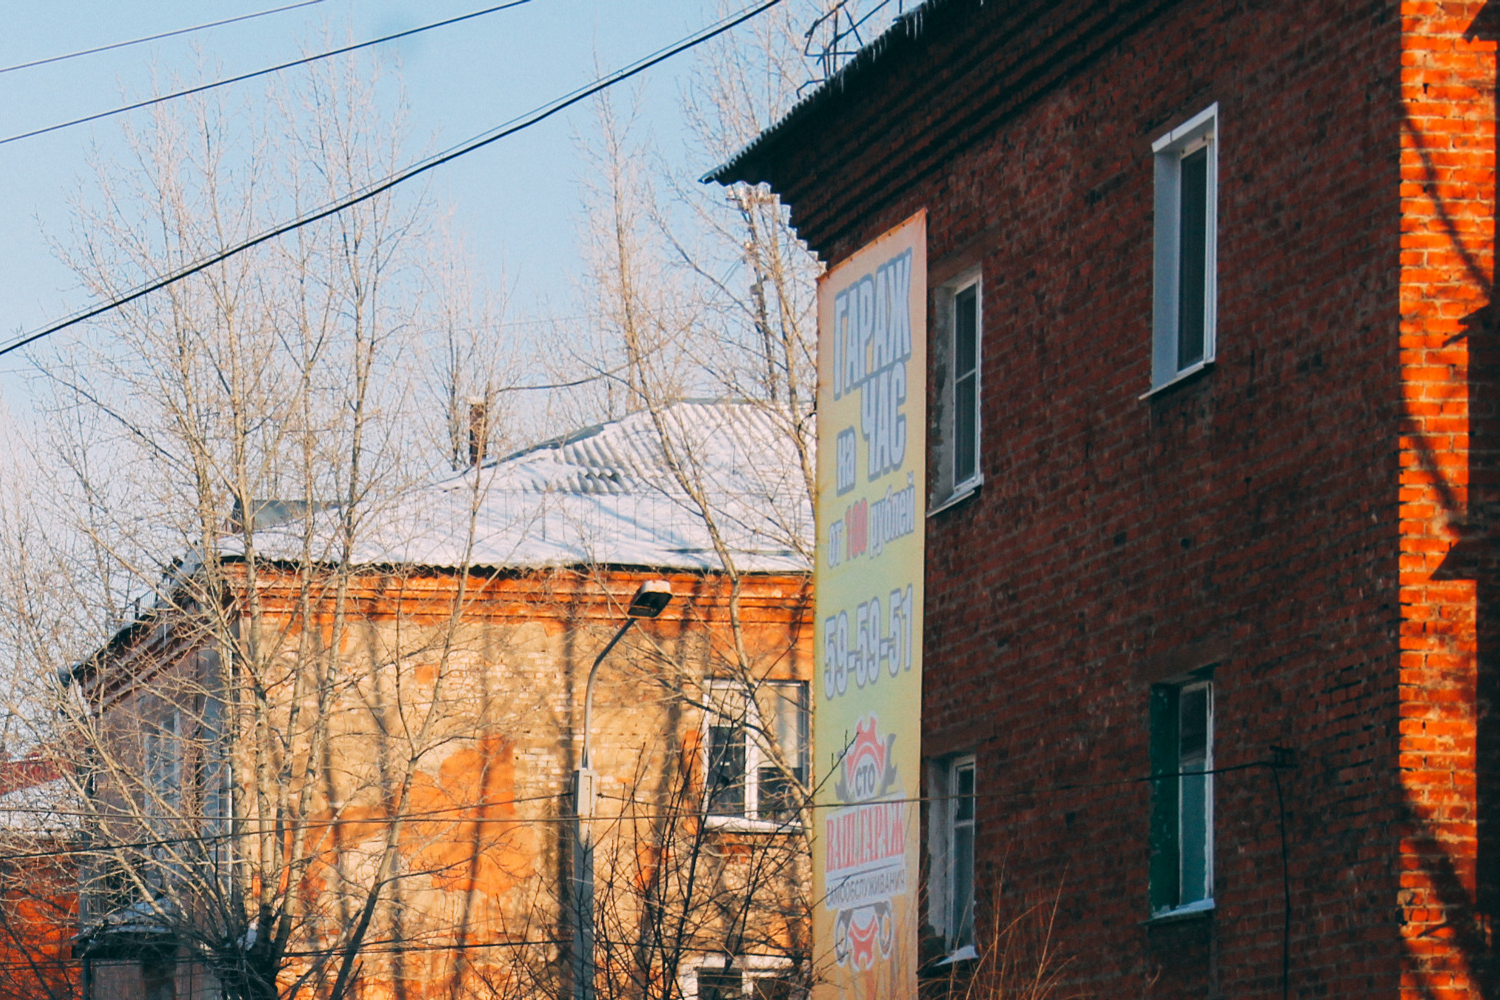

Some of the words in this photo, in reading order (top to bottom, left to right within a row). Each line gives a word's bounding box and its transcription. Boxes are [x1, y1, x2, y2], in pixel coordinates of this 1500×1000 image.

[834, 248, 912, 400] ГАРАЖ
[836, 427, 856, 496] на
[861, 361, 906, 481] ЧАС
[828, 519, 843, 569] от
[845, 498, 867, 560] 100
[868, 471, 915, 559] рублей
[824, 584, 912, 700] 59-59-51
[855, 762, 875, 797] СТО
[826, 812, 856, 872] ВАШ
[860, 802, 905, 865] ГАРАЖ
